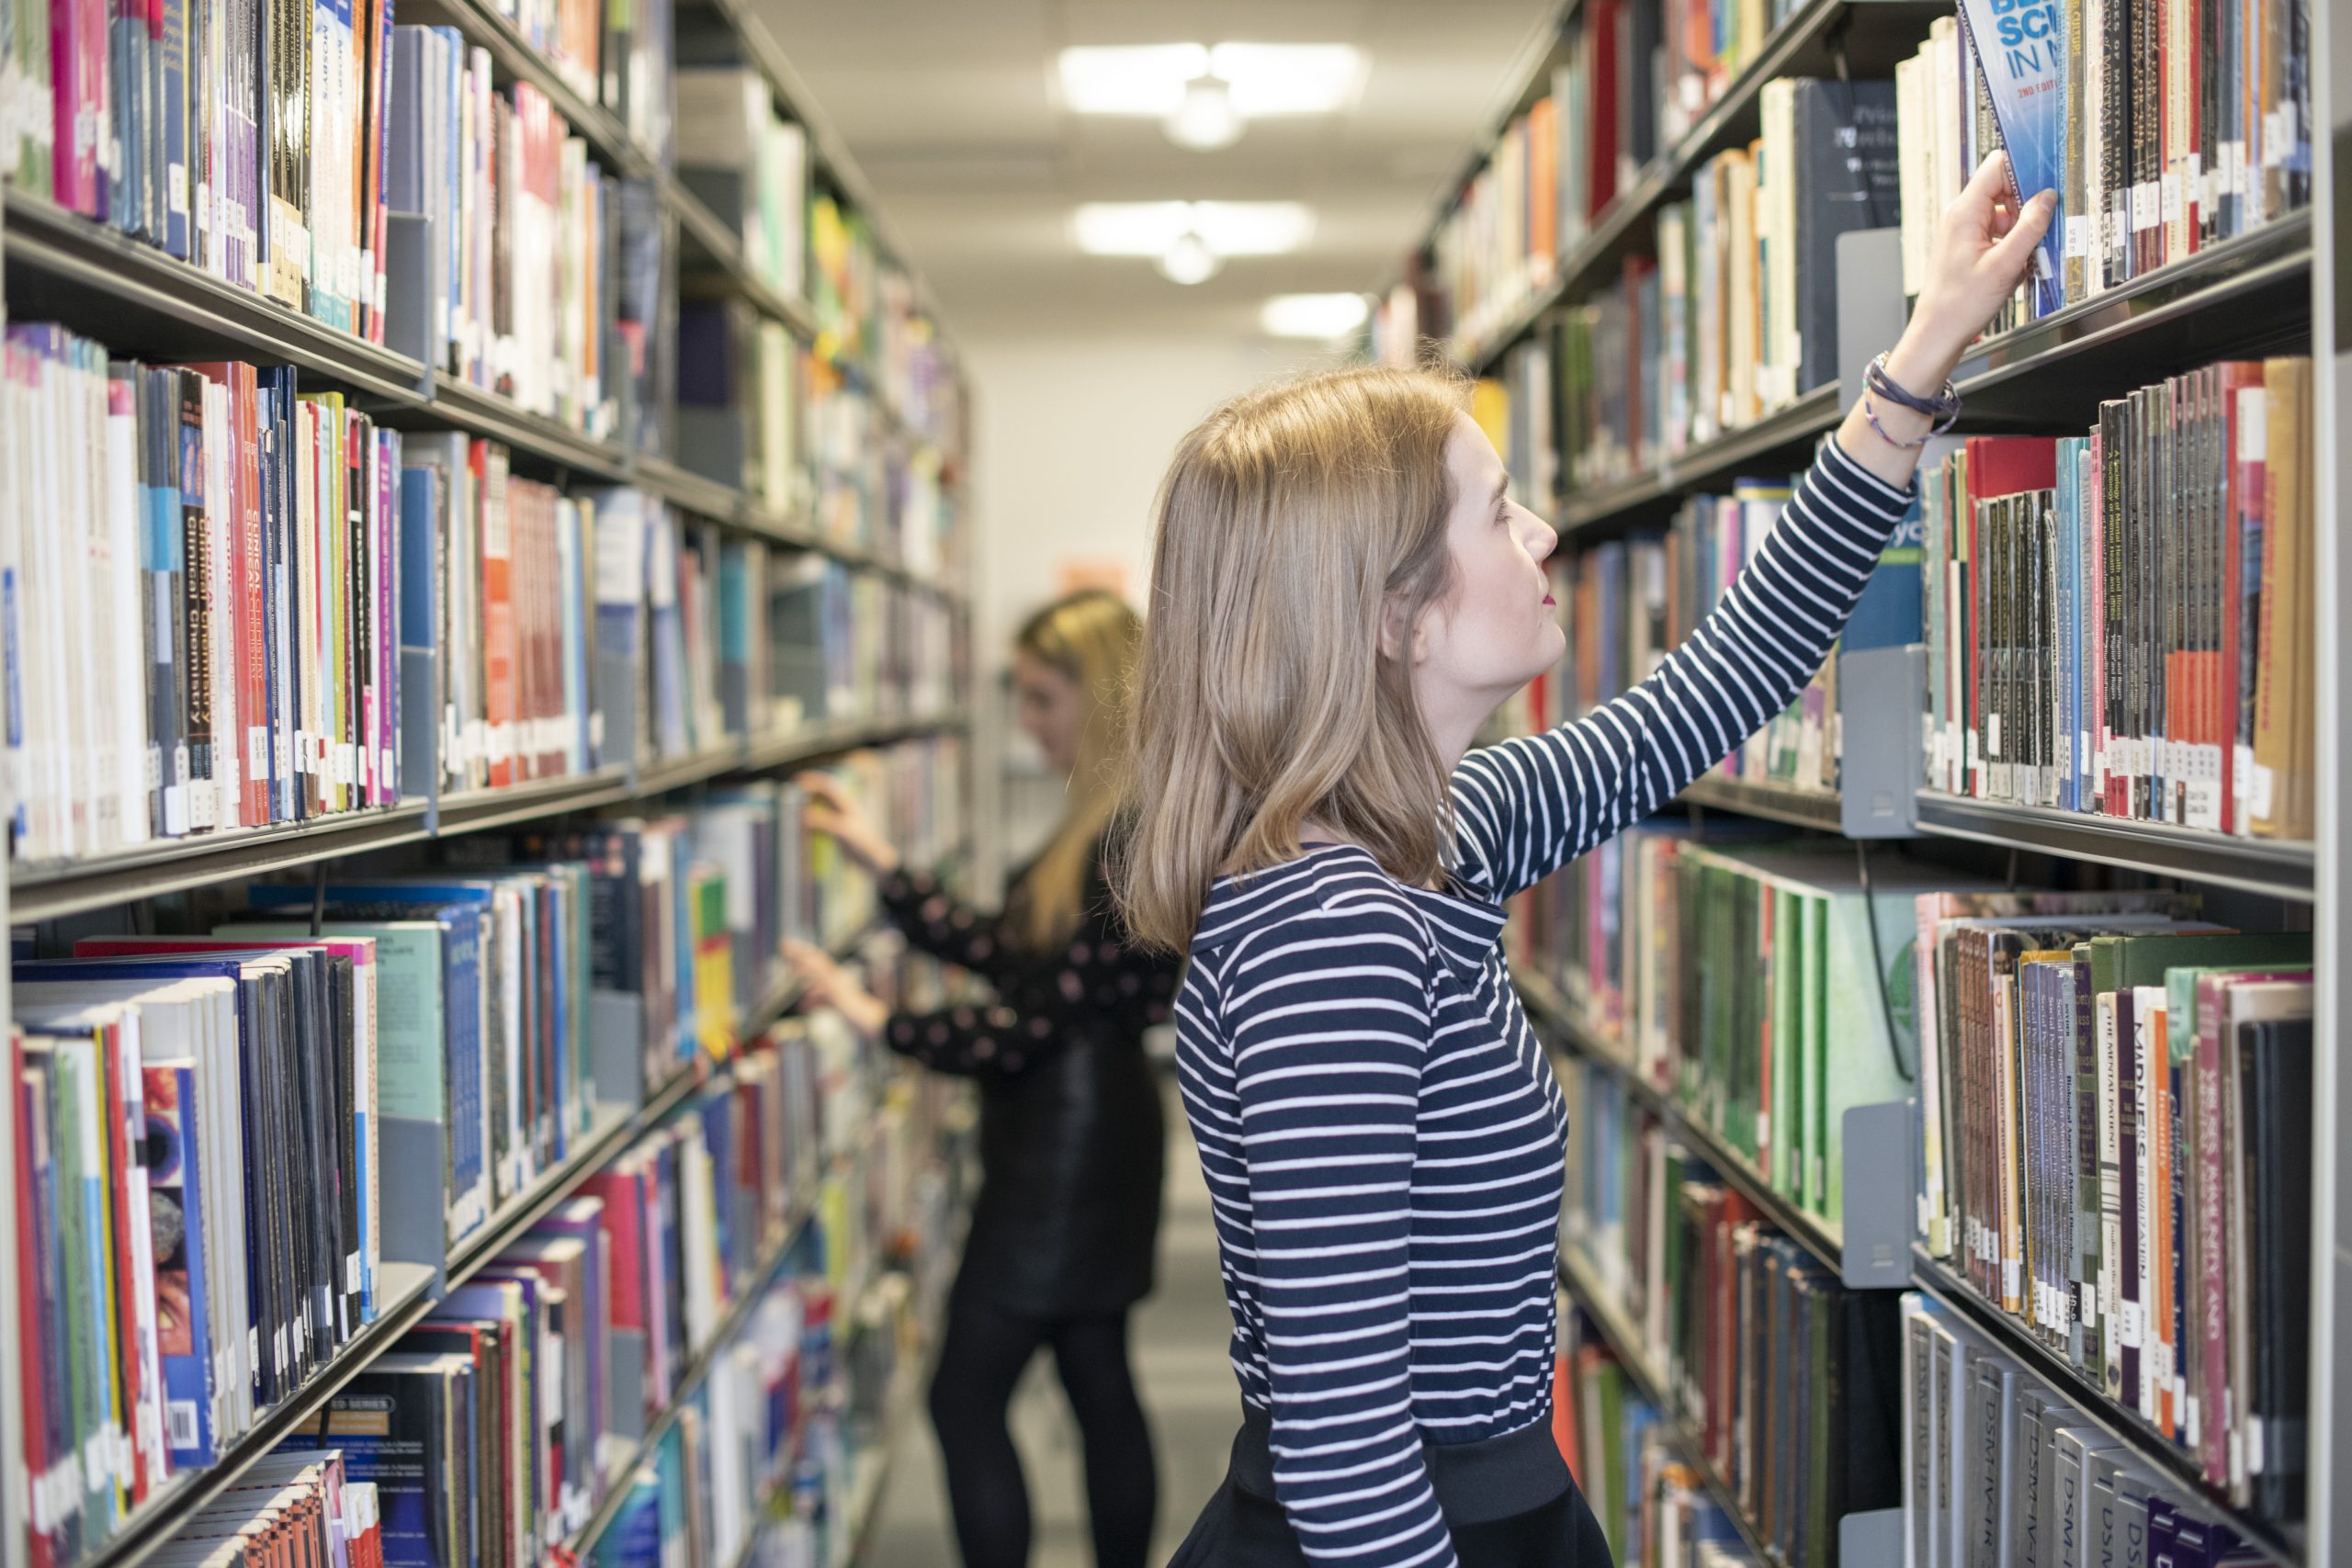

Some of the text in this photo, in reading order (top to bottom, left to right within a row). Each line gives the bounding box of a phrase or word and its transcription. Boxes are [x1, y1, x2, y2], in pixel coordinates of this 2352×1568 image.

[2006, 43, 2041, 80] IN
[2114, 39, 2120, 60] OF
[2018, 86, 2035, 99] 2ND
[2103, 54, 2111, 125] MENTAL
[2108, 451, 2113, 459] A
[2113, 458, 2121, 500] Sociology
[2109, 503, 2114, 512] of
[2115, 502, 2121, 511] of
[245, 509, 256, 681] CLINICAL CHEMISTRY
[253, 510, 264, 682] CLINICAL CHEMISTRY
[187, 516, 200, 724] Clinical Chemistry
[198, 517, 211, 724] Clinical Chemistry
[2049, 1033, 2057, 1101] Perspectives
[2057, 1035, 2065, 1104] Perspectives
[2032, 1098, 2039, 1109] in
[2042, 1101, 2049, 1112] in
[2051, 1105, 2057, 1115] in
[2134, 1021, 2146, 1157] MADNESS
[2059, 1108, 2066, 1118] in
[2158, 1089, 2168, 1171] Insanity
[2068, 1166, 2074, 1178] of
[2206, 1068, 2220, 1341] VIRUSES IMMUNITY AND
[2138, 1182, 2146, 1280] CIVILIZATION
